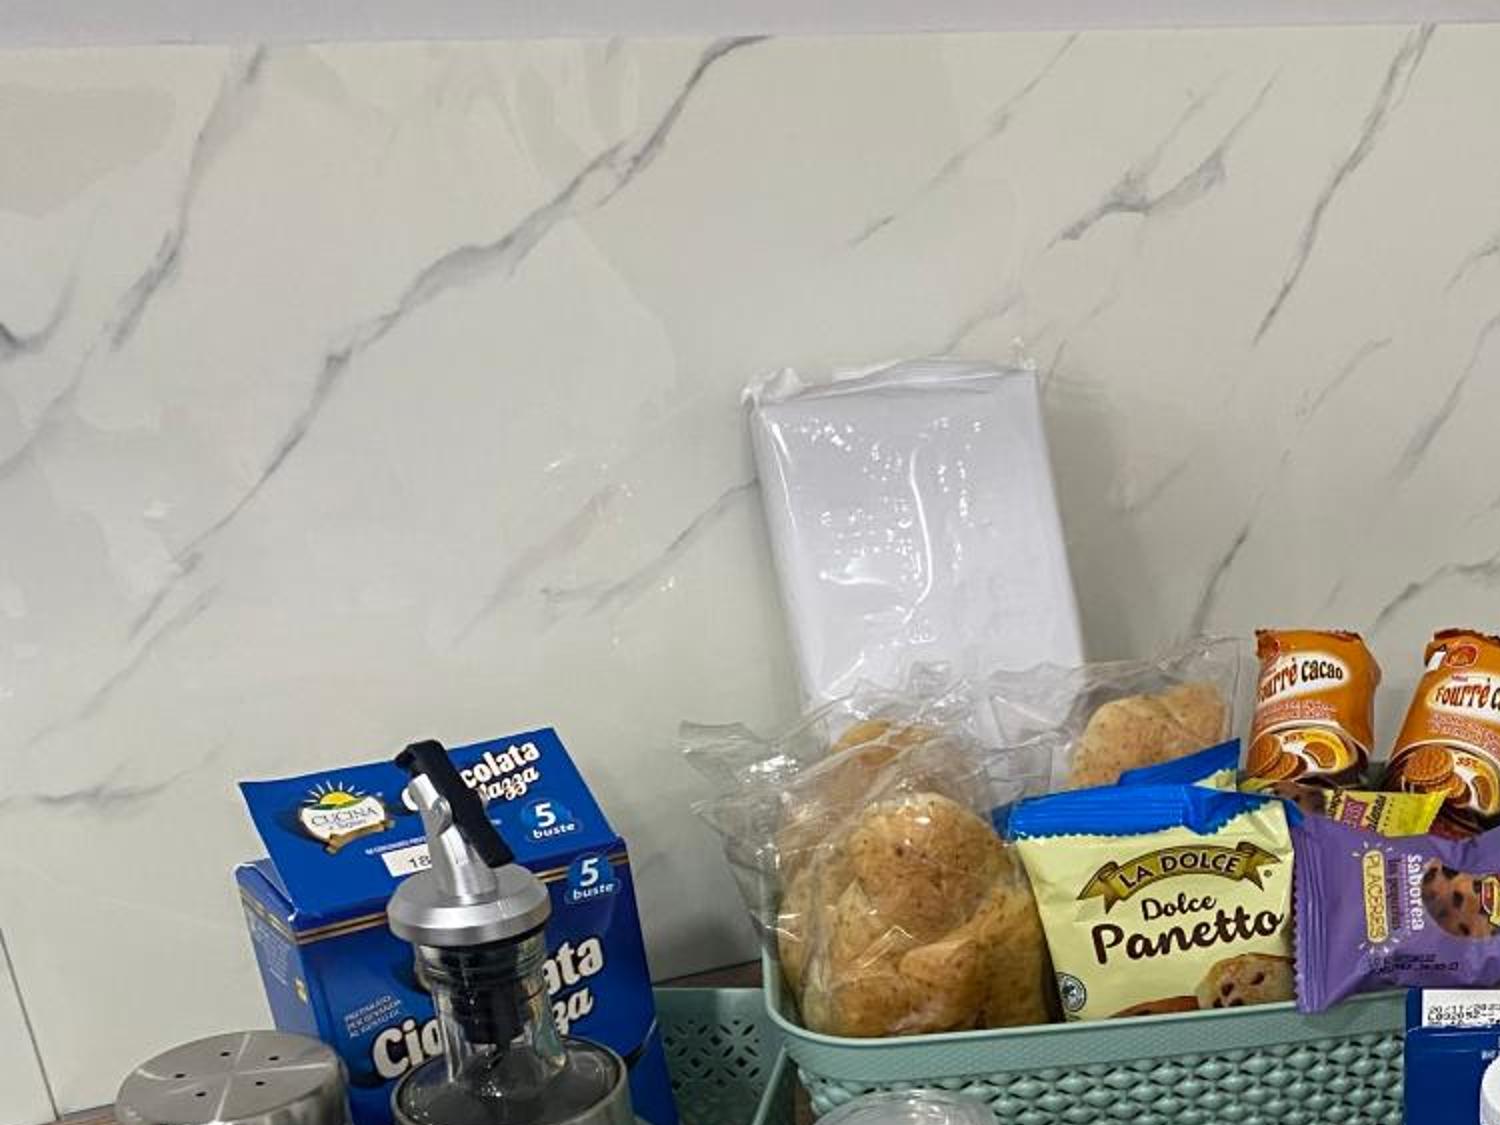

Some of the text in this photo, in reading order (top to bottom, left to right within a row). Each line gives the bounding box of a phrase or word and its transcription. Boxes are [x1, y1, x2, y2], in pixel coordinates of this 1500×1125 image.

[1301, 659, 1344, 682] cacao
[534, 802, 558, 828] 5
[532, 822, 576, 840] buste
[580, 857, 600, 886] 5
[1119, 852, 1241, 889] LA DOLCE
[573, 882, 614, 901] buste
[1141, 892, 1217, 921] Dolce
[1091, 905, 1284, 965] Panetto
